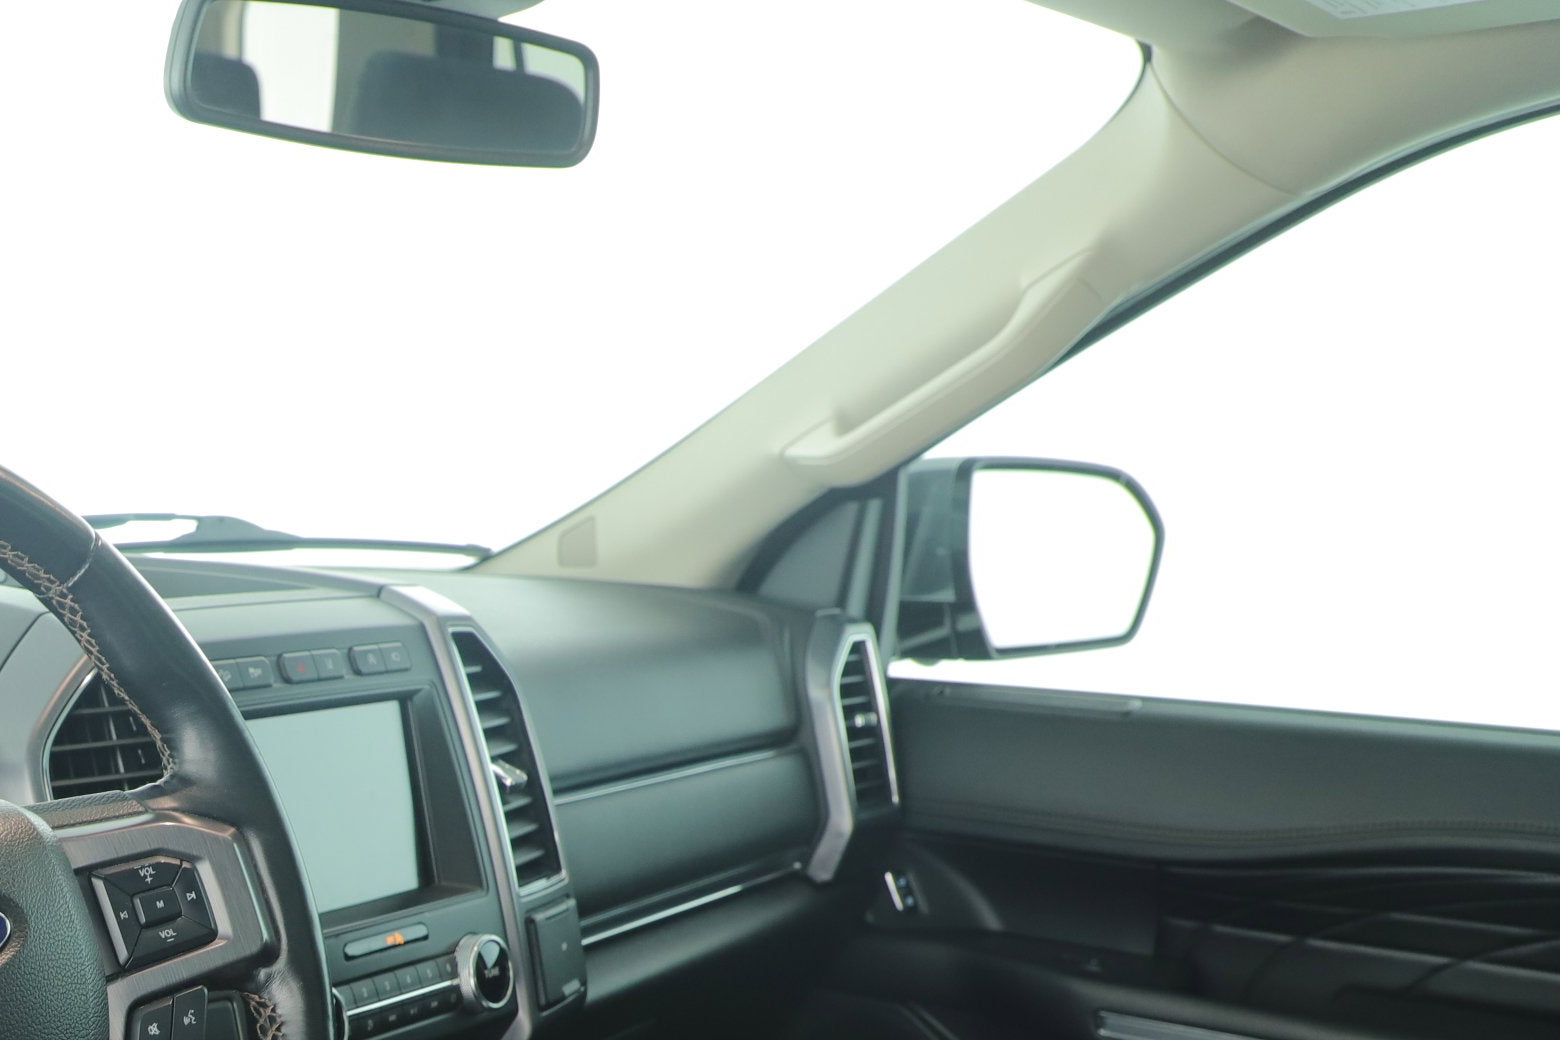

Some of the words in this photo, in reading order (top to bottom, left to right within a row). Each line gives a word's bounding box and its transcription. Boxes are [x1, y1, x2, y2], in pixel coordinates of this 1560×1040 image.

[138, 866, 157, 877] VOL
[155, 899, 165, 909] M
[158, 928, 177, 939] VOL
